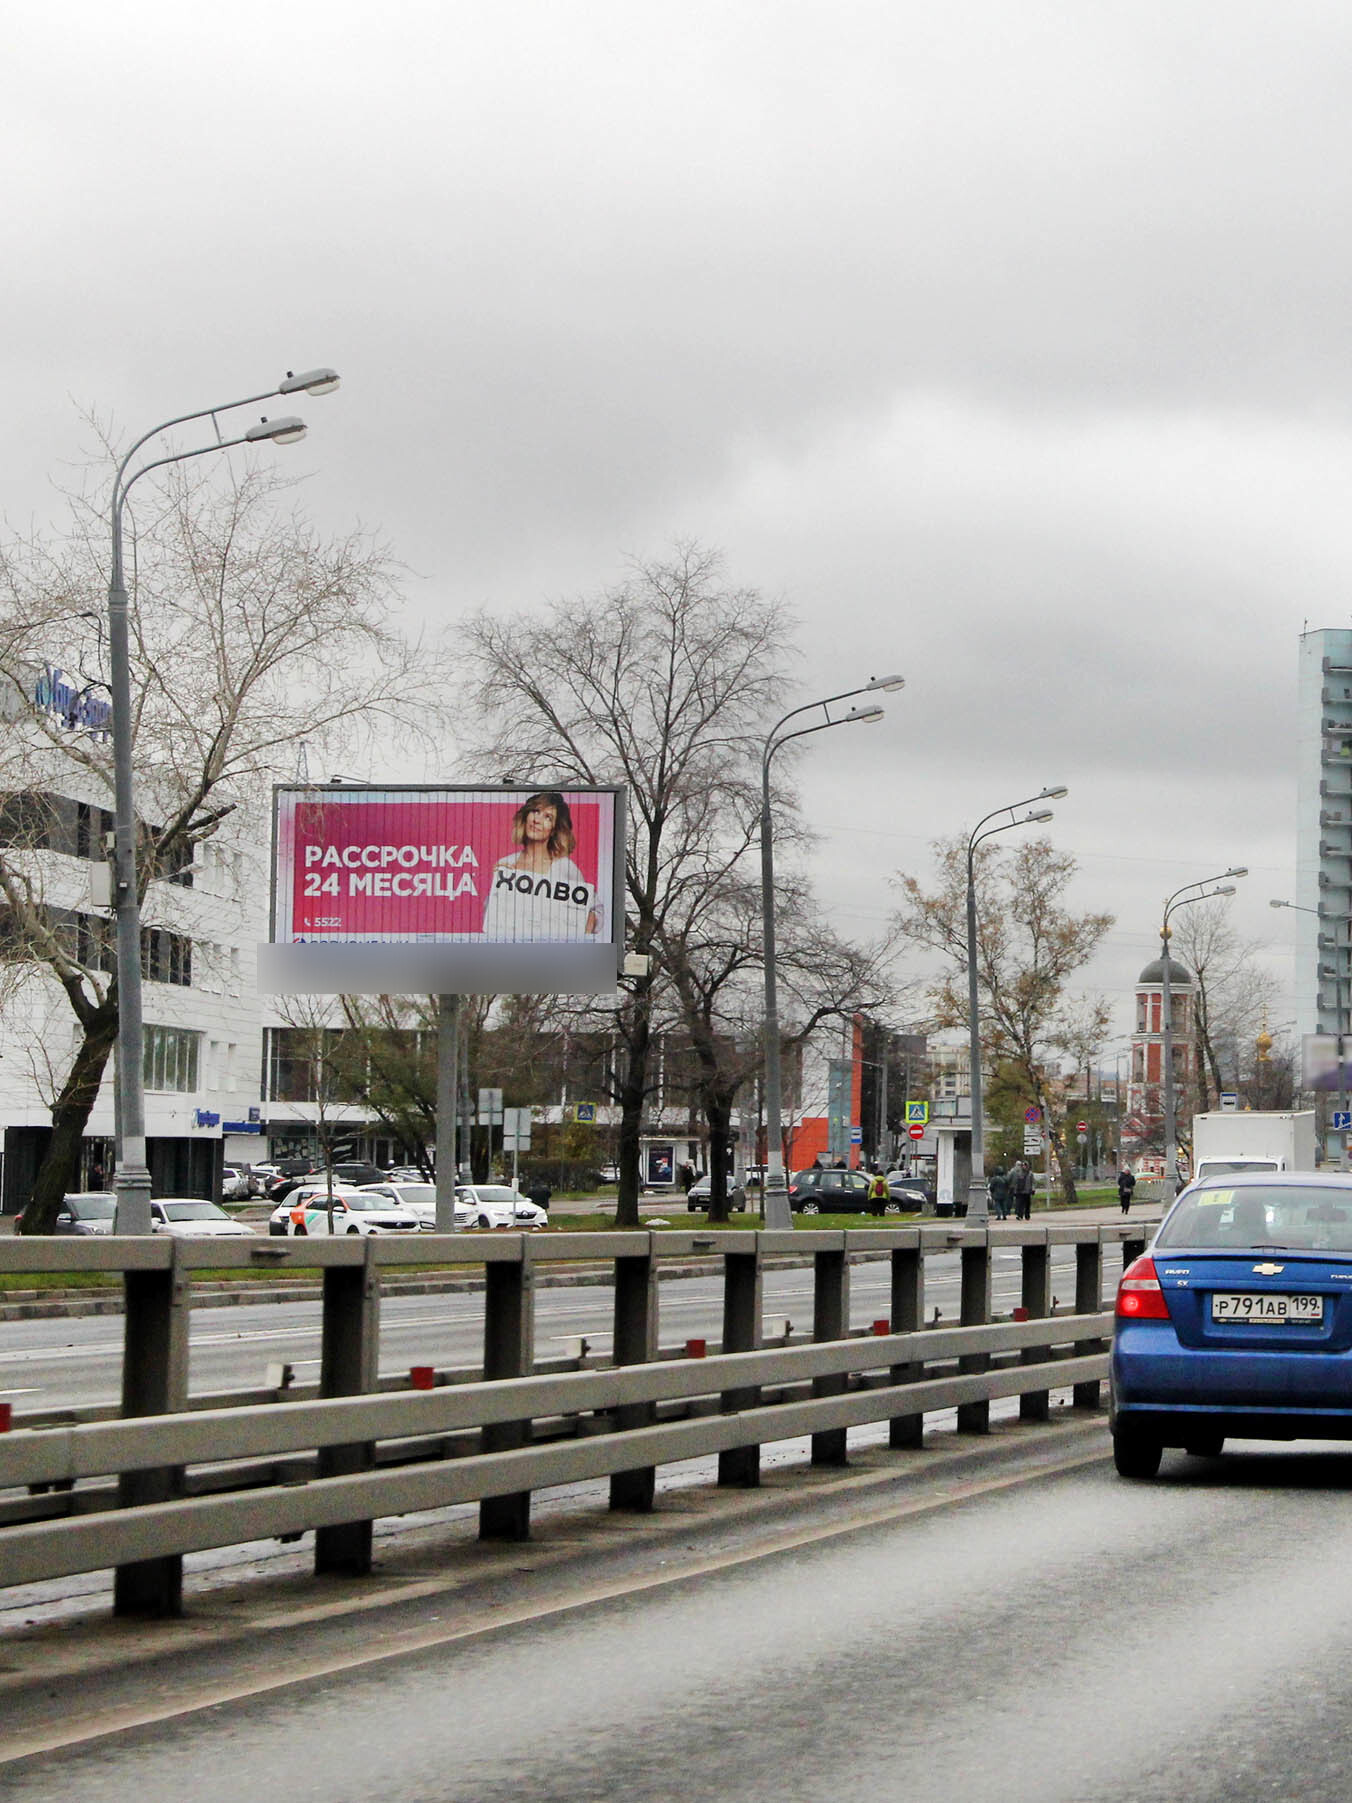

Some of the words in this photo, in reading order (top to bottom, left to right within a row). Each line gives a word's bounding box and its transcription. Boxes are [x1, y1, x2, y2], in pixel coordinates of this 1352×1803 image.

[304, 845, 479, 868] РАССРОЧКА
[304, 873, 341, 897] 24
[350, 872, 478, 901] МЕСЯЦА
[314, 917, 342, 927] 5522
